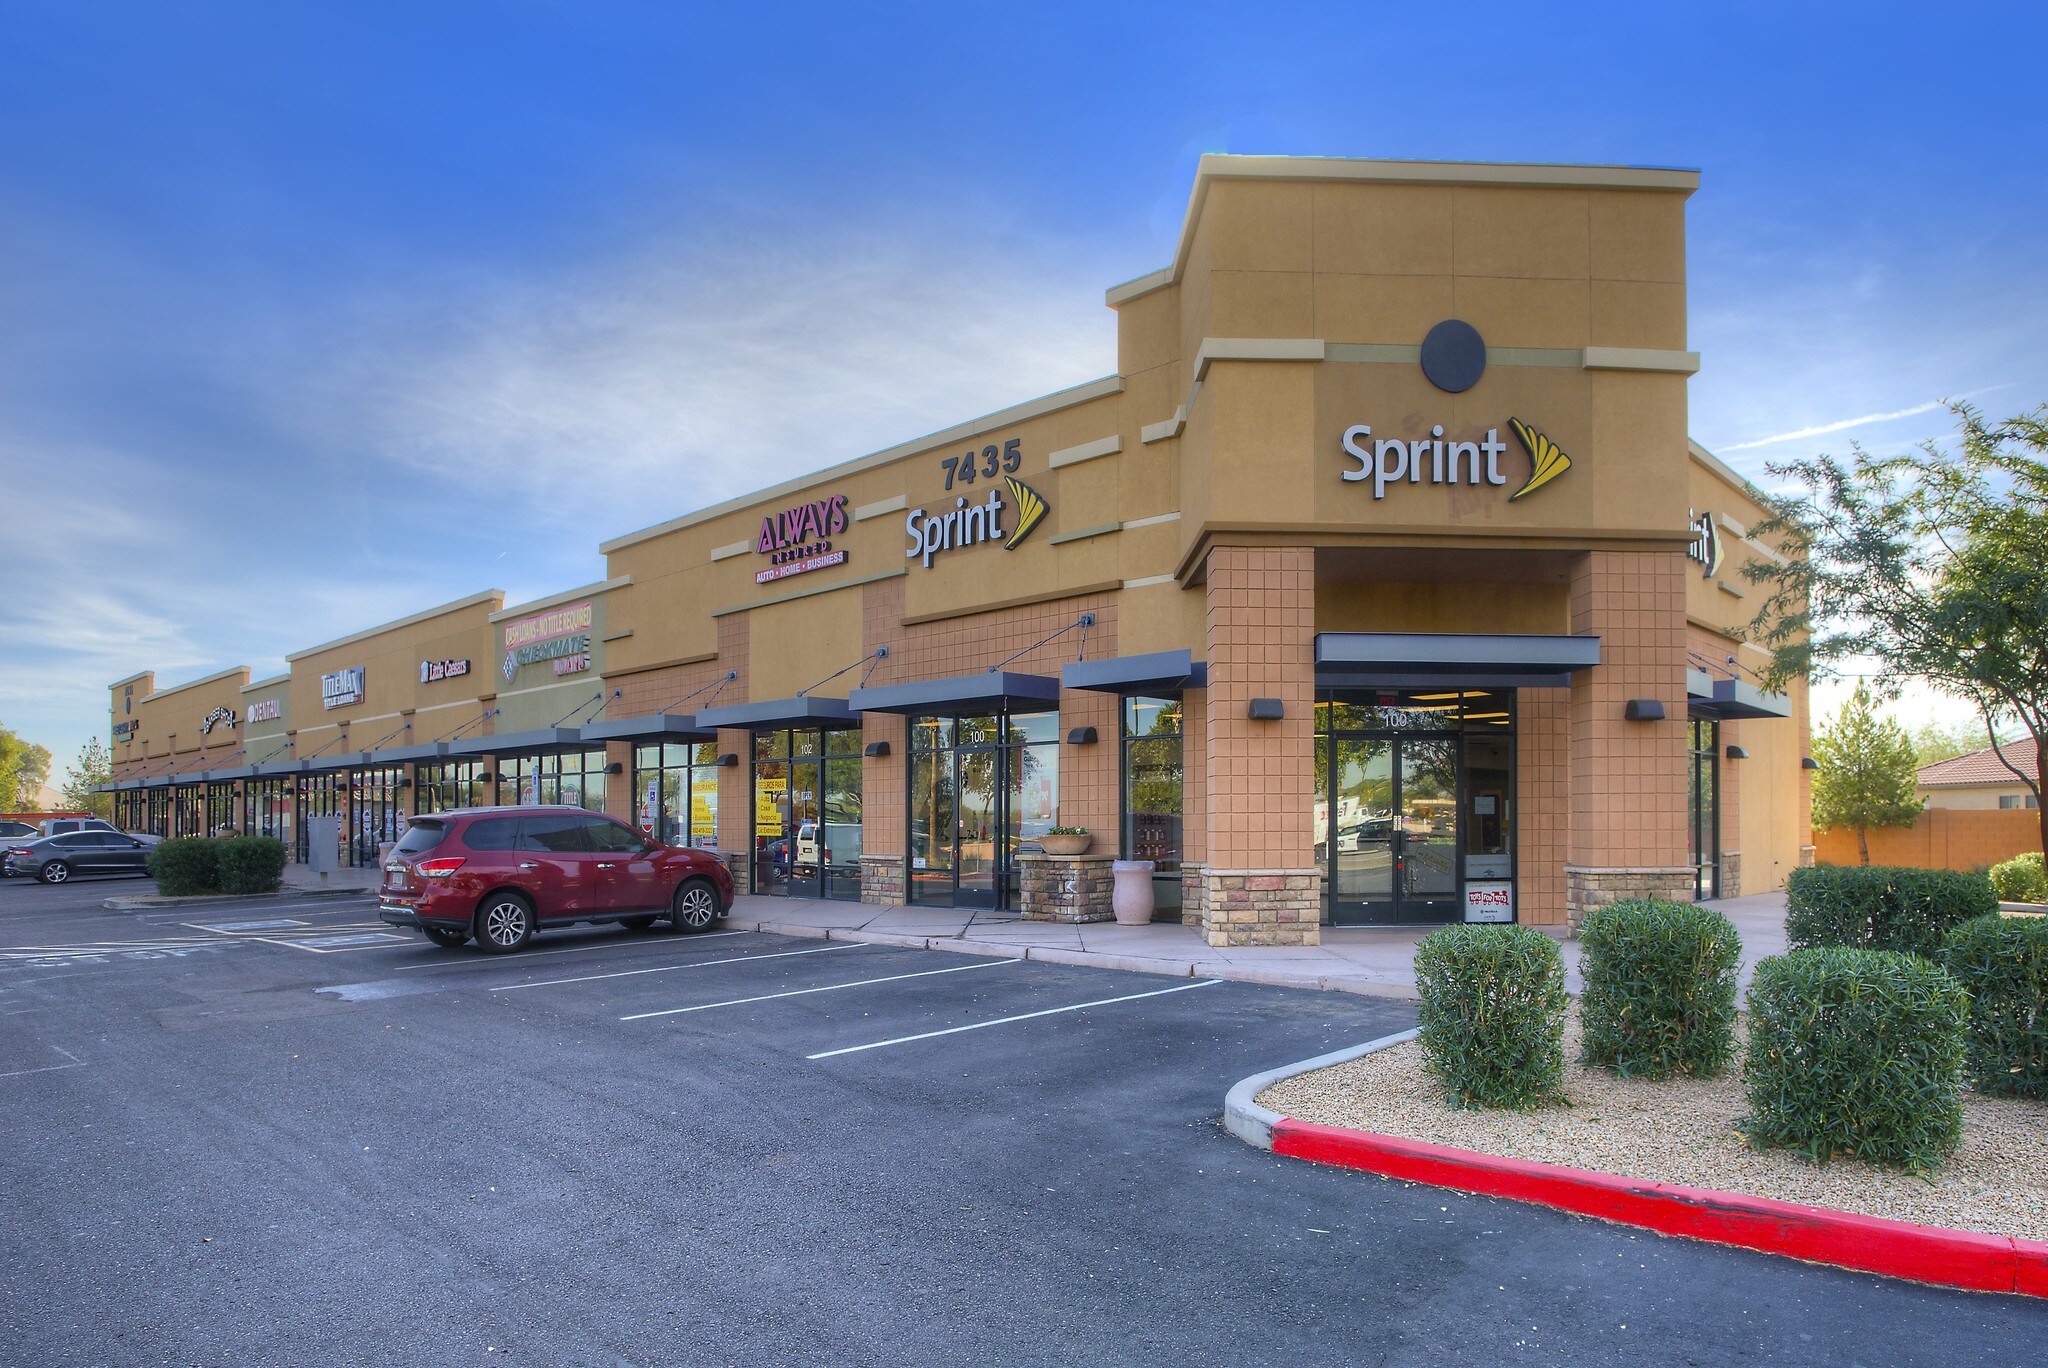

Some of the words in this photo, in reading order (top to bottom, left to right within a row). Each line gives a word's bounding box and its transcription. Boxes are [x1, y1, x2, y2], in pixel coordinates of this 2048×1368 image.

[941, 438, 1021, 490] 7435
[1340, 424, 1507, 500] Sprint
[756, 494, 848, 554] ALWAYS
[906, 489, 1006, 569] Sprint
[771, 540, 832, 565] INSURED
[756, 570, 775, 583] AUTO
[780, 562, 800, 577] HOME
[807, 551, 844, 570] BUSINESS
[505, 625, 519, 646] CASH
[519, 620, 537, 642] LOANS
[540, 617, 548, 637] NO
[548, 613, 563, 634] TITLE
[563, 606, 592, 631] REQUIRED
[516, 634, 588, 665] CHECKMATE
[553, 653, 589, 676] LOANS
[254, 699, 281, 722] DENTAL
[1383, 713, 1408, 727] 100
[801, 743, 813, 756] 102
[970, 730, 985, 743] 100
[563, 791, 578, 805] TITLE
